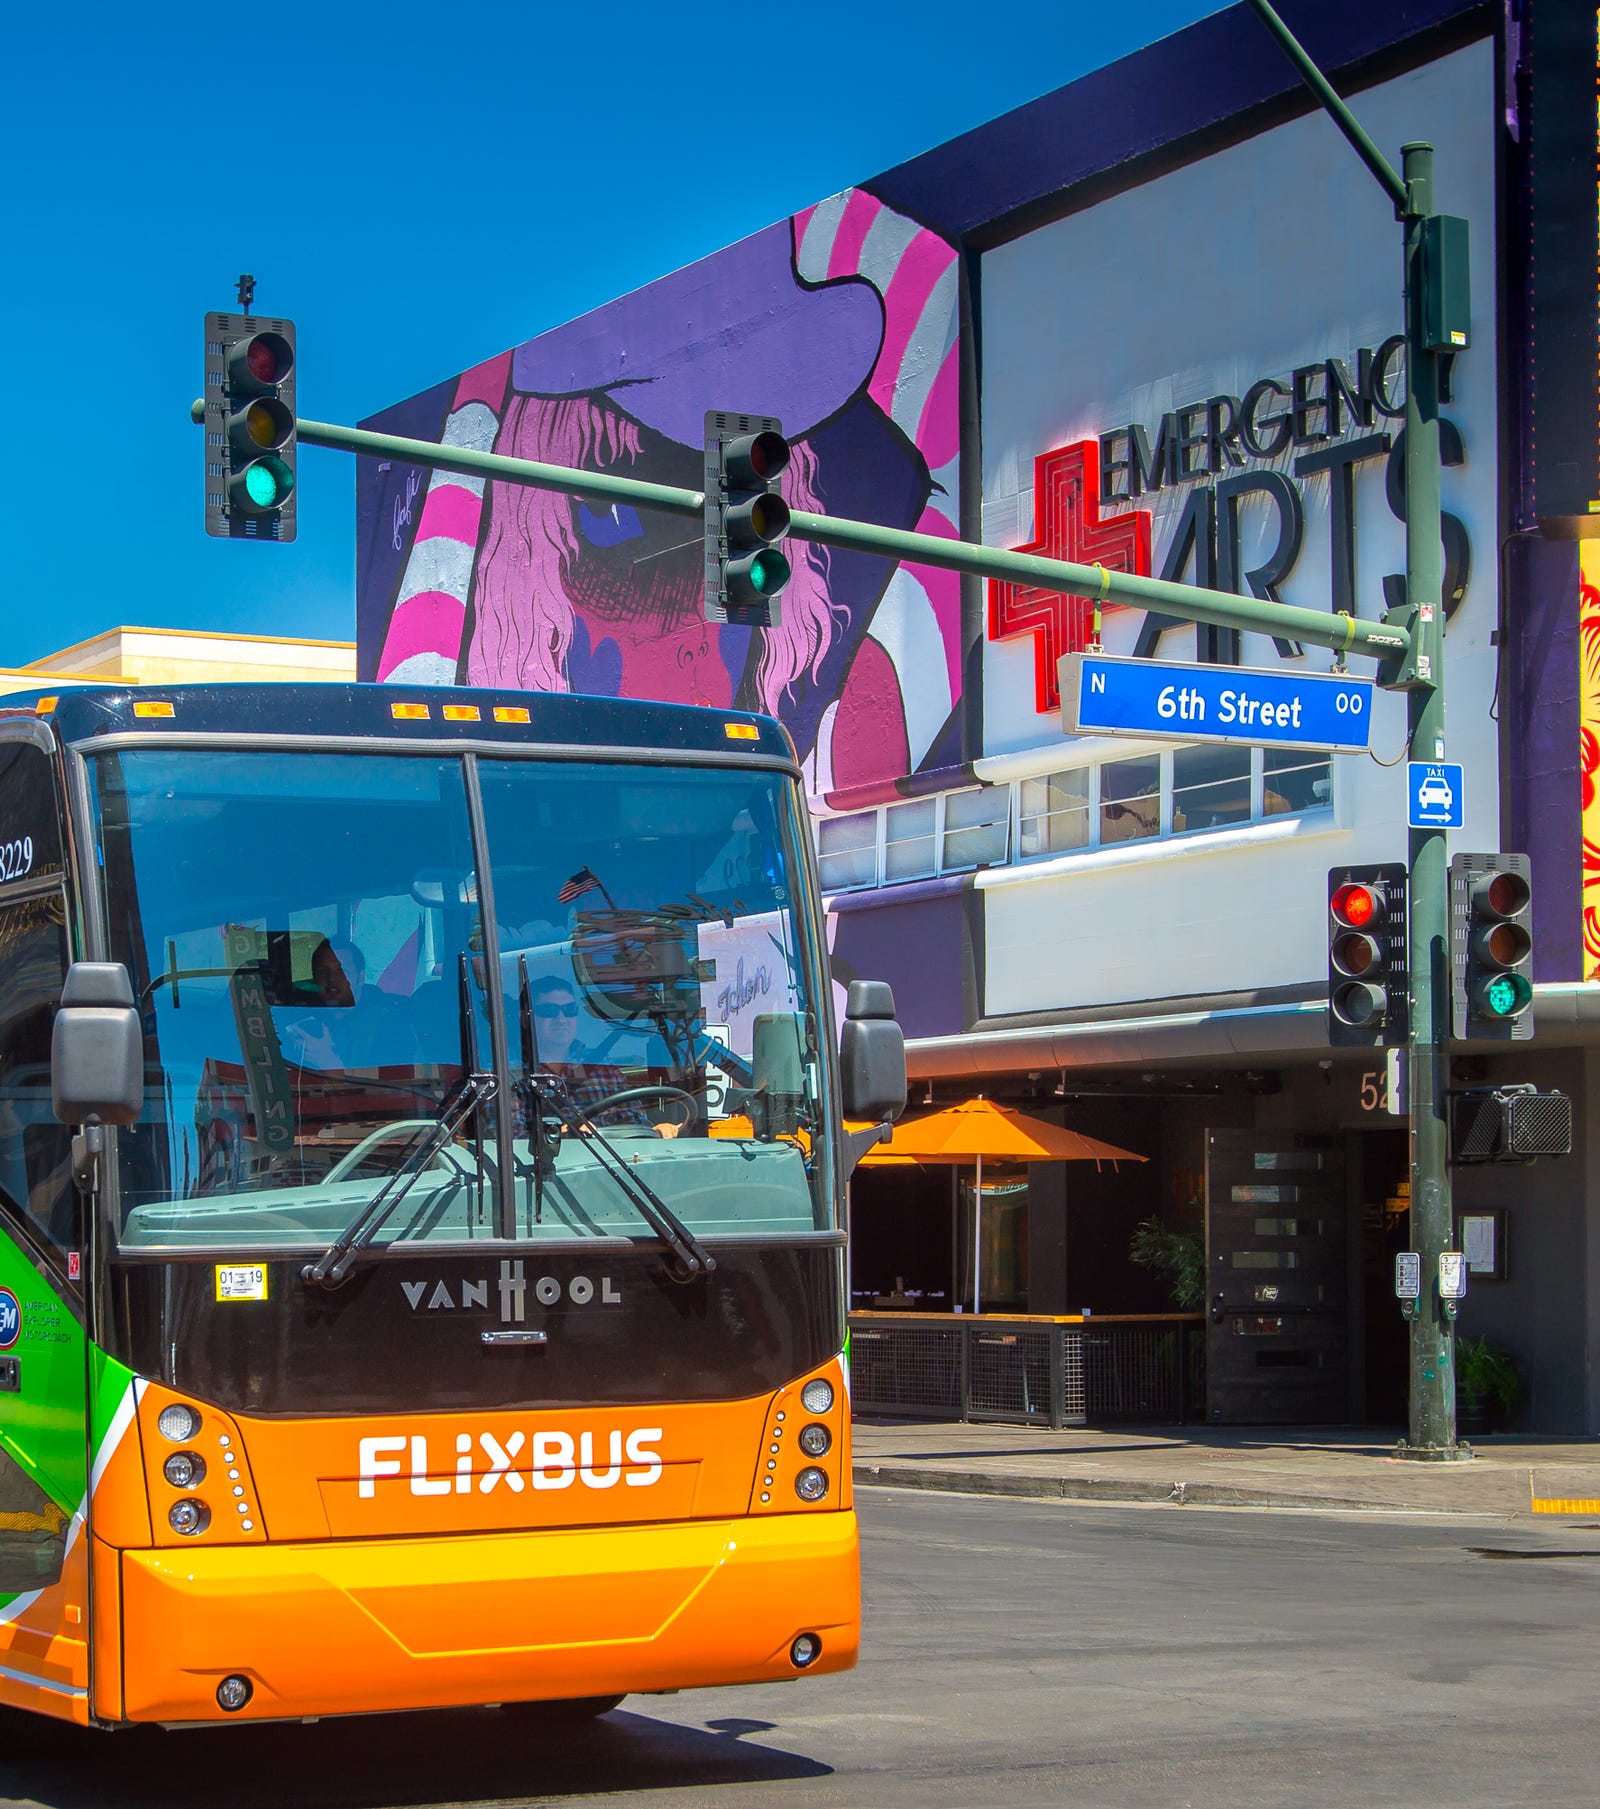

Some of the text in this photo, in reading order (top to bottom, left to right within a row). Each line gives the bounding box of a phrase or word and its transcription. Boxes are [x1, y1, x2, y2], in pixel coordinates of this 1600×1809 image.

[1099, 334, 1456, 502] EMERGENC
[1133, 413, 1471, 665] ARTS
[1090, 672, 1106, 695] N
[1157, 685, 1206, 721] 6th
[1217, 690, 1303, 729] Street
[1426, 767, 1446, 778] TAXI
[220, 1270, 234, 1284] 01
[249, 1269, 263, 1283] 19
[24, 1301, 59, 1312] AMERICAN
[24, 1315, 61, 1328] EXPLORER
[24, 1330, 72, 1344] MOTORCOACH
